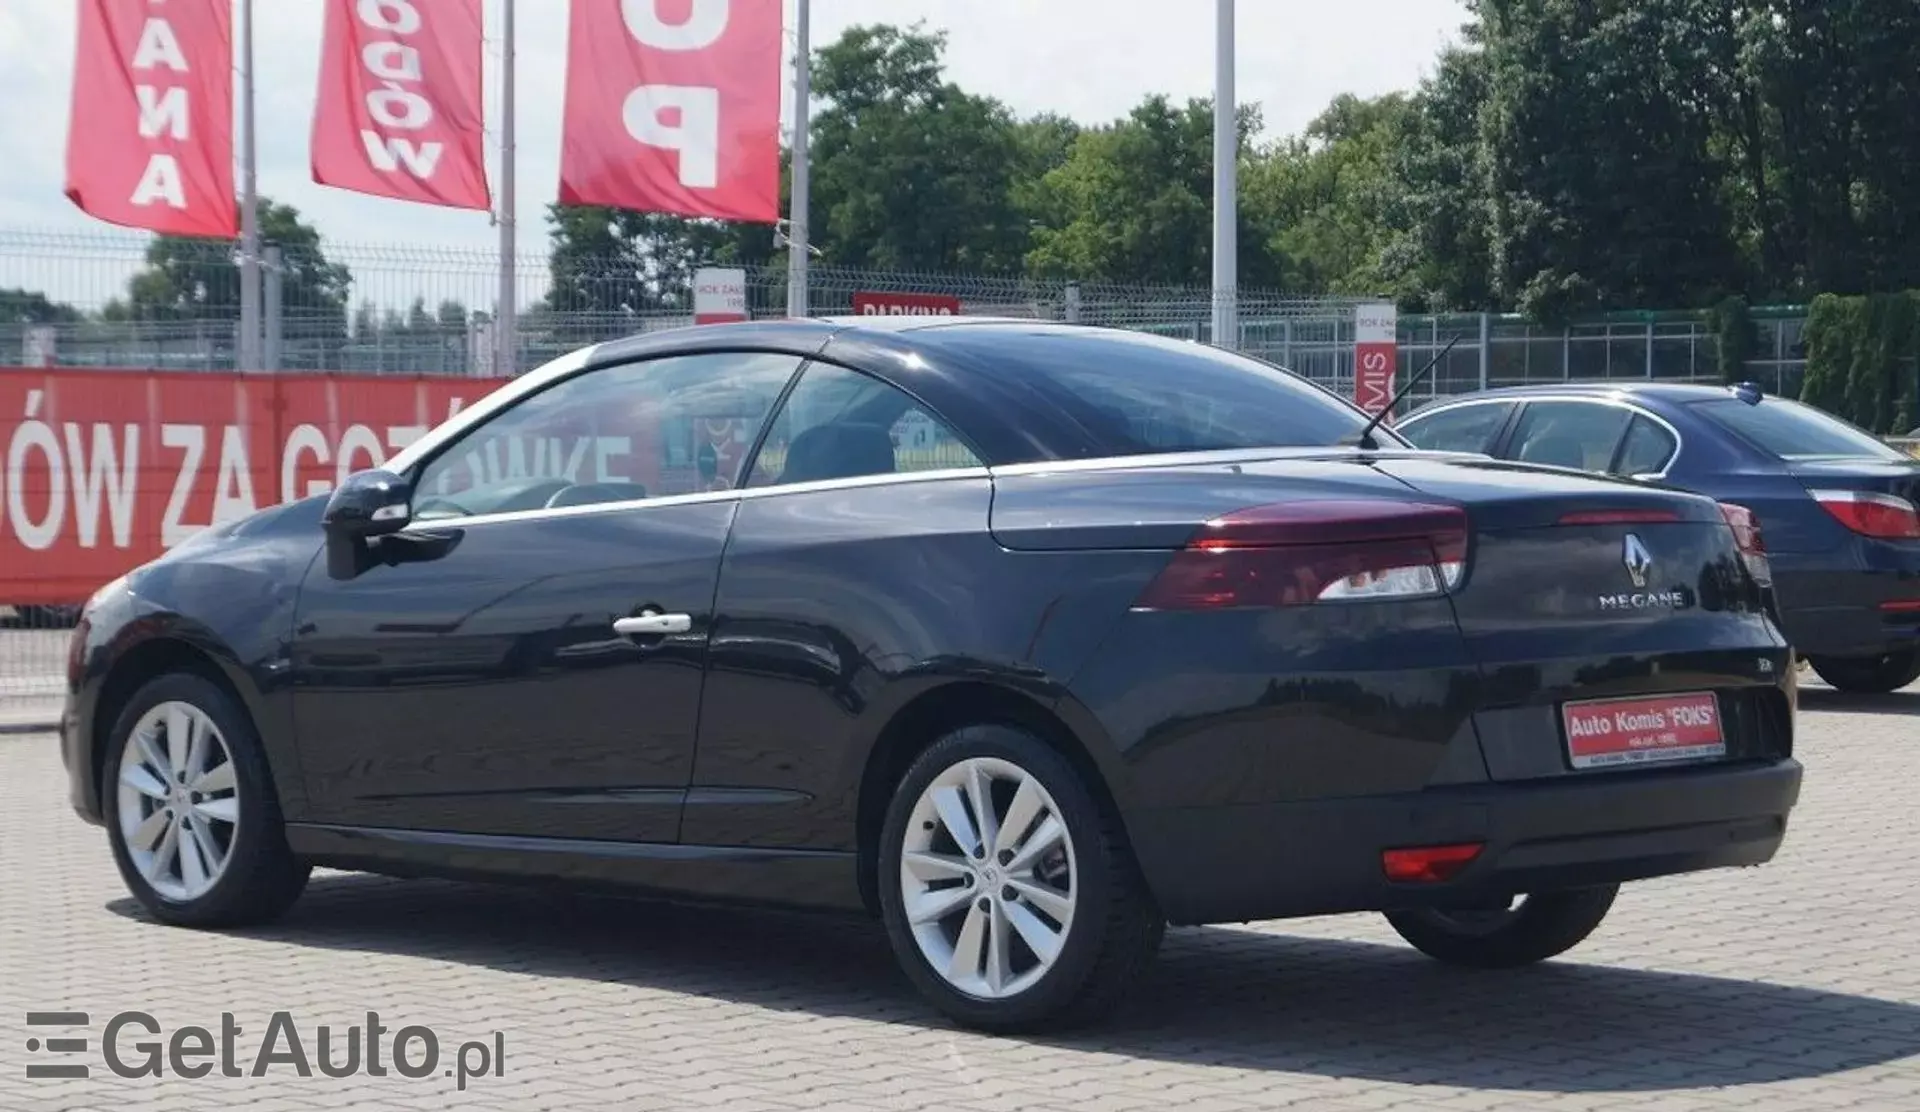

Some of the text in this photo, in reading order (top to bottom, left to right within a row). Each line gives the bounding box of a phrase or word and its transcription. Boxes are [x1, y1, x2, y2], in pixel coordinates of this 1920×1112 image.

[0, 390, 139, 549] ÓW
[161, 423, 257, 548] ZA
[1599, 592, 1684, 610] MEGANE
[1571, 715, 1612, 737] Auto
[1615, 708, 1665, 732] Komis
